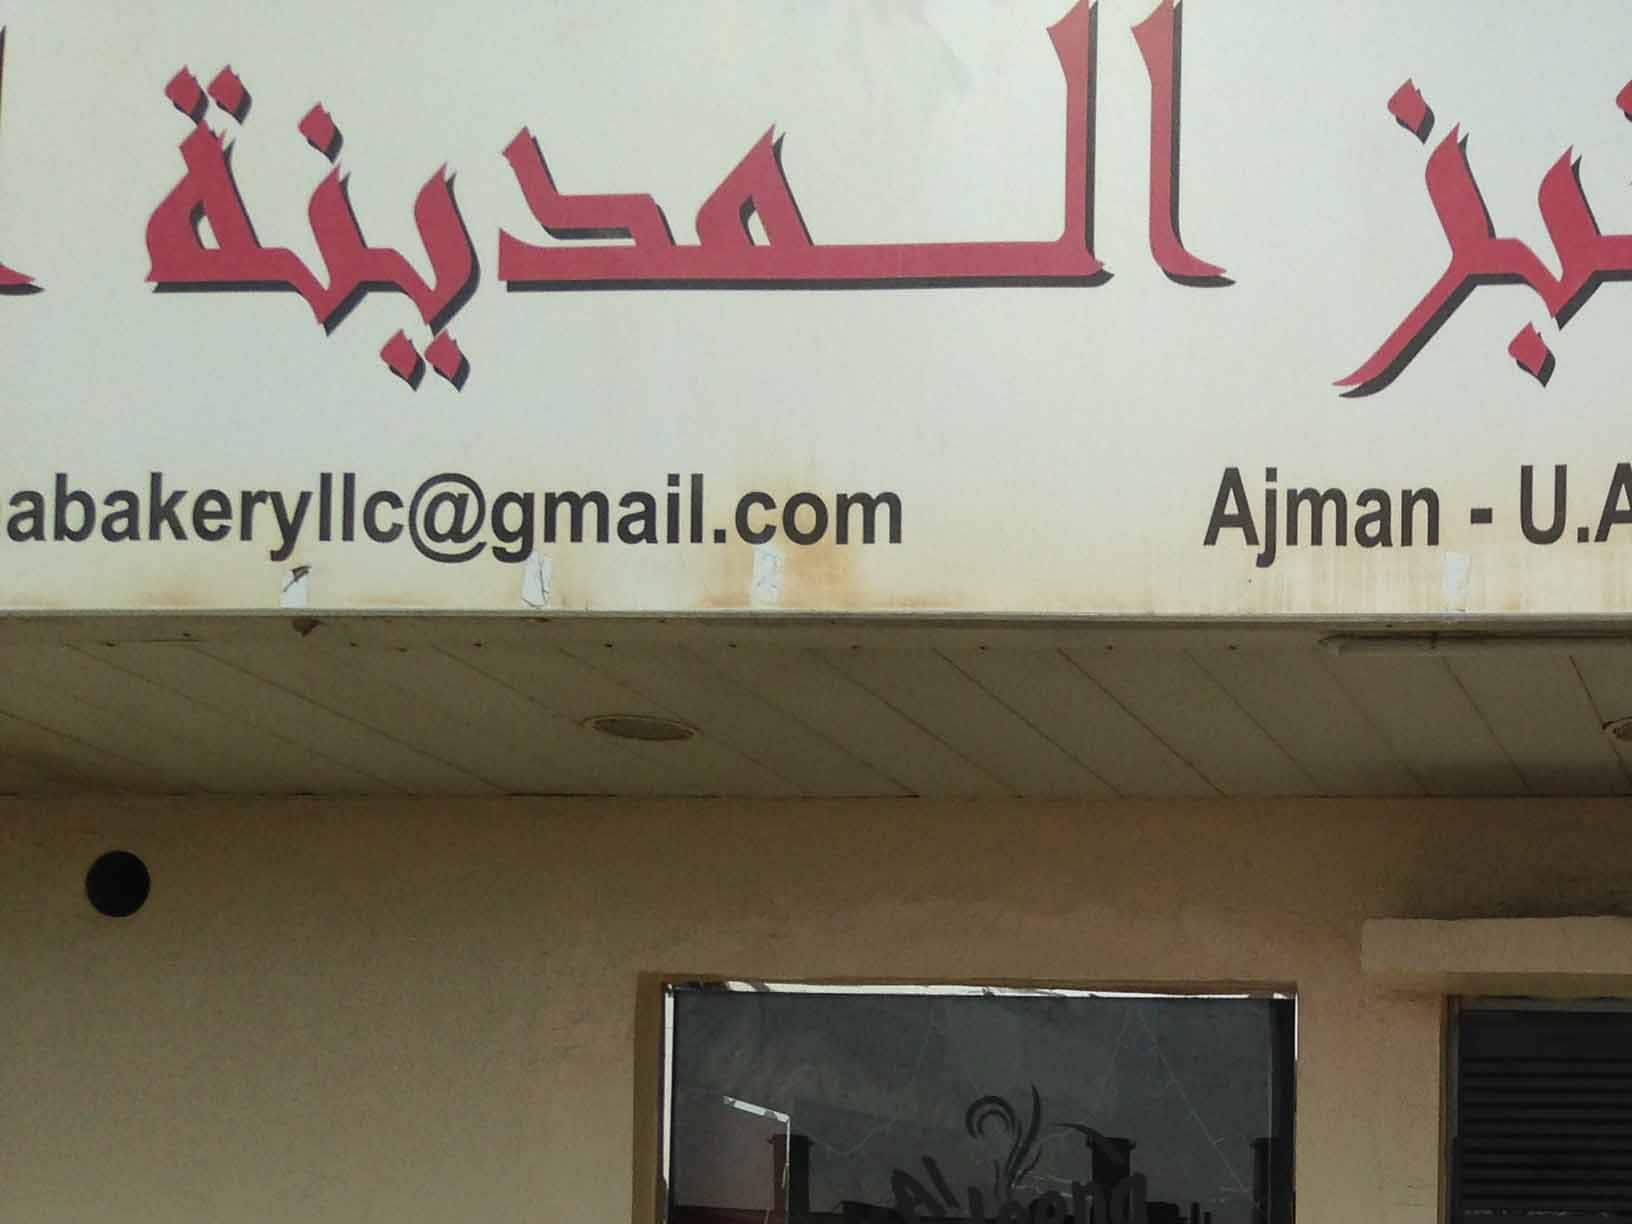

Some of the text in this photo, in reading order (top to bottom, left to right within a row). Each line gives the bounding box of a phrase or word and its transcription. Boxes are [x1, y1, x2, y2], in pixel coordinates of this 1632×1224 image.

[147, 0, 1234, 391] المدينة
[6, 471, 902, 564] abakeryllc@gmail.com
[1204, 467, 1440, 568] Ajman
[1470, 507, 1493, 525] -
